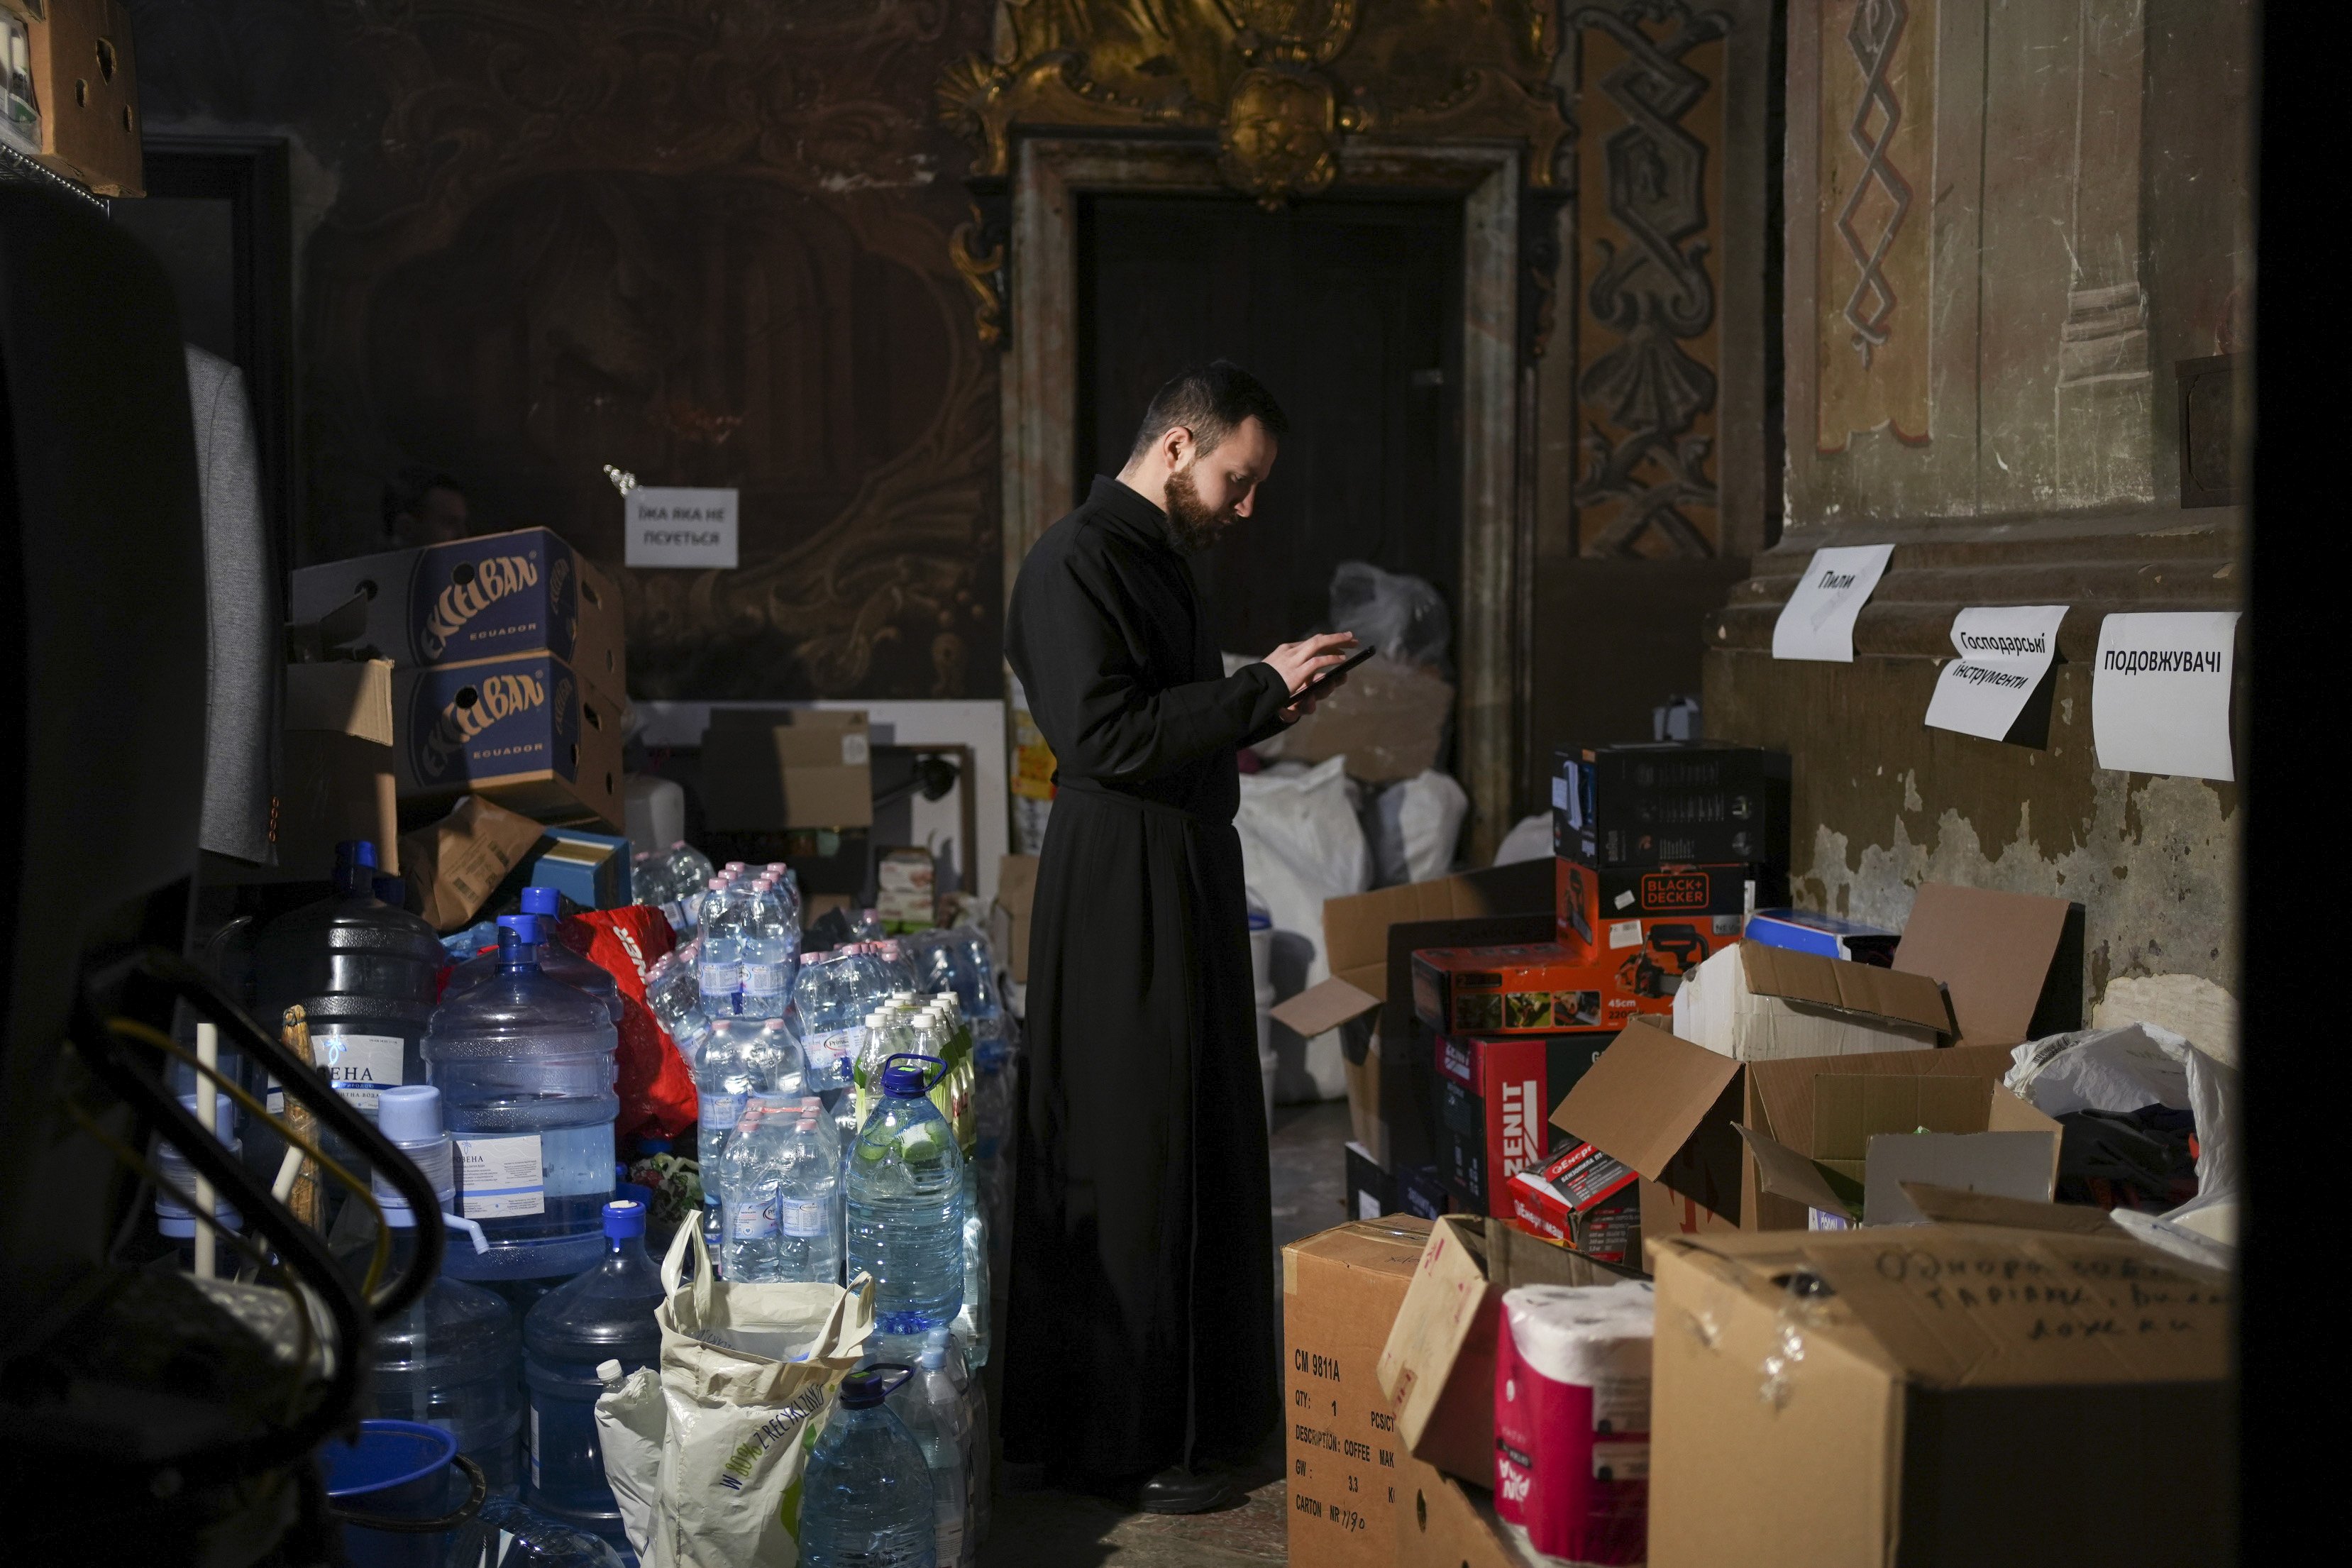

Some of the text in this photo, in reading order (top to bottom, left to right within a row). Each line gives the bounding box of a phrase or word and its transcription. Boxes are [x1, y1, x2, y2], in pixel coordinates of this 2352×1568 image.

[706, 507, 724, 522] НЕ
[1818, 570, 1855, 589] Пили
[469, 622, 537, 641] ECUADOR
[1960, 632, 2045, 656] Господарські
[1953, 661, 2028, 689] інструменти
[2104, 651, 2221, 675] ПОДОВЖУВАЧІ
[473, 742, 543, 760] ECUADOR
[1647, 891, 1704, 903] DECKER
[1502, 1081, 1523, 1178] ZENIT
[1295, 1348, 1341, 1383] CM 9811A
[1295, 1389, 1311, 1410] QTY:
[1331, 1400, 1337, 1417] 1
[1296, 1424, 1341, 1453] DESCRIPTION:
[1344, 1439, 1371, 1462] COFFEE
[719, 1474, 743, 1490] W
[753, 1432, 769, 1450] Z
[1348, 1475, 1359, 1494] 3.3
[1388, 1486, 1395, 1504] K
[1296, 1494, 1340, 1523] CARTON NR
